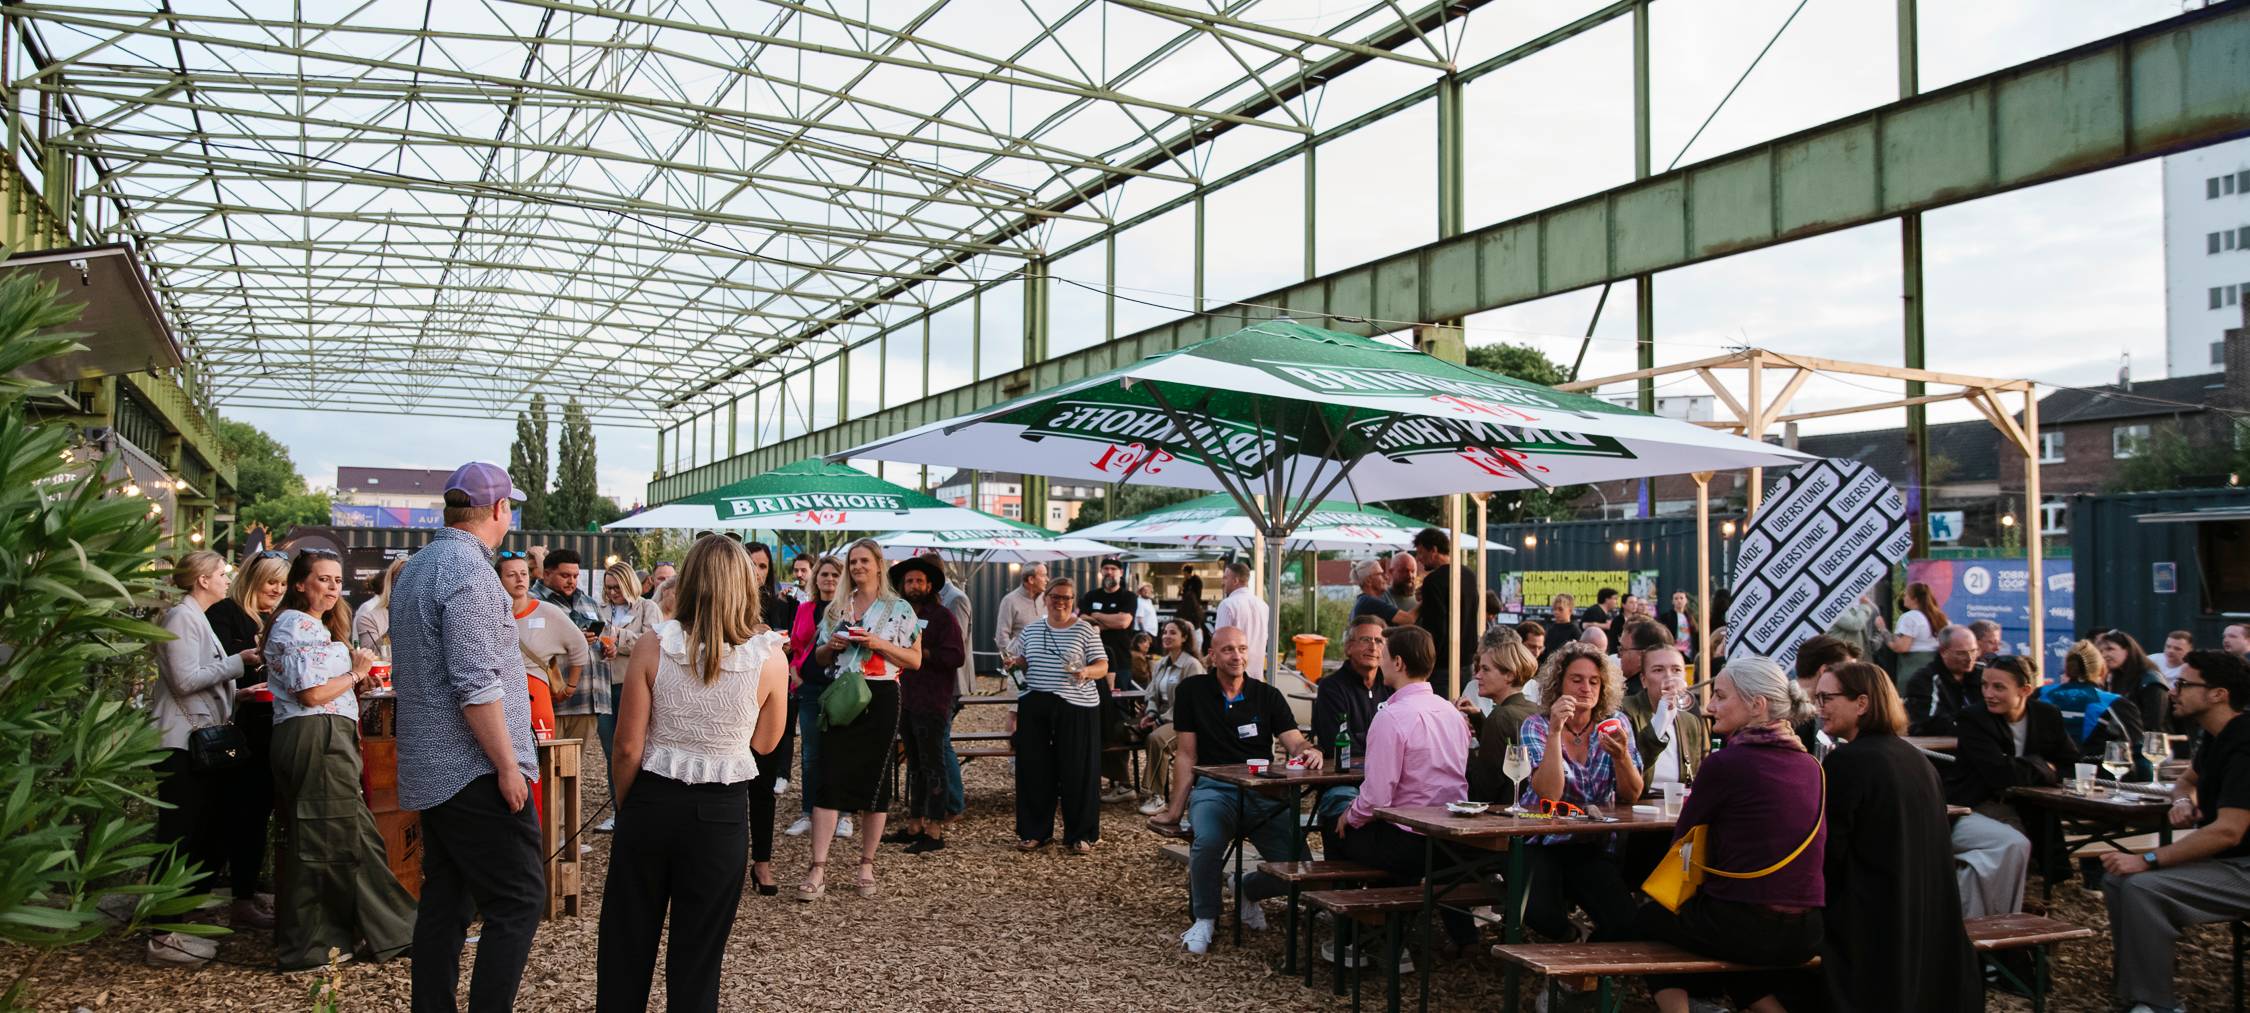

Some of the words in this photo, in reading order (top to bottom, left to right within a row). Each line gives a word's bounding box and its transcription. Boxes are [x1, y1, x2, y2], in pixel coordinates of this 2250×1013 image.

[1769, 475, 1830, 532] ÜBERSTUNDE
[1769, 522, 1828, 579] ÜBERSTUNDE
[1817, 519, 1879, 576] ÜBERSTUNDE
[1752, 585, 1811, 644] ÜBERSTUNDE
[1818, 566, 1878, 624] ÜBERSTUNDE
